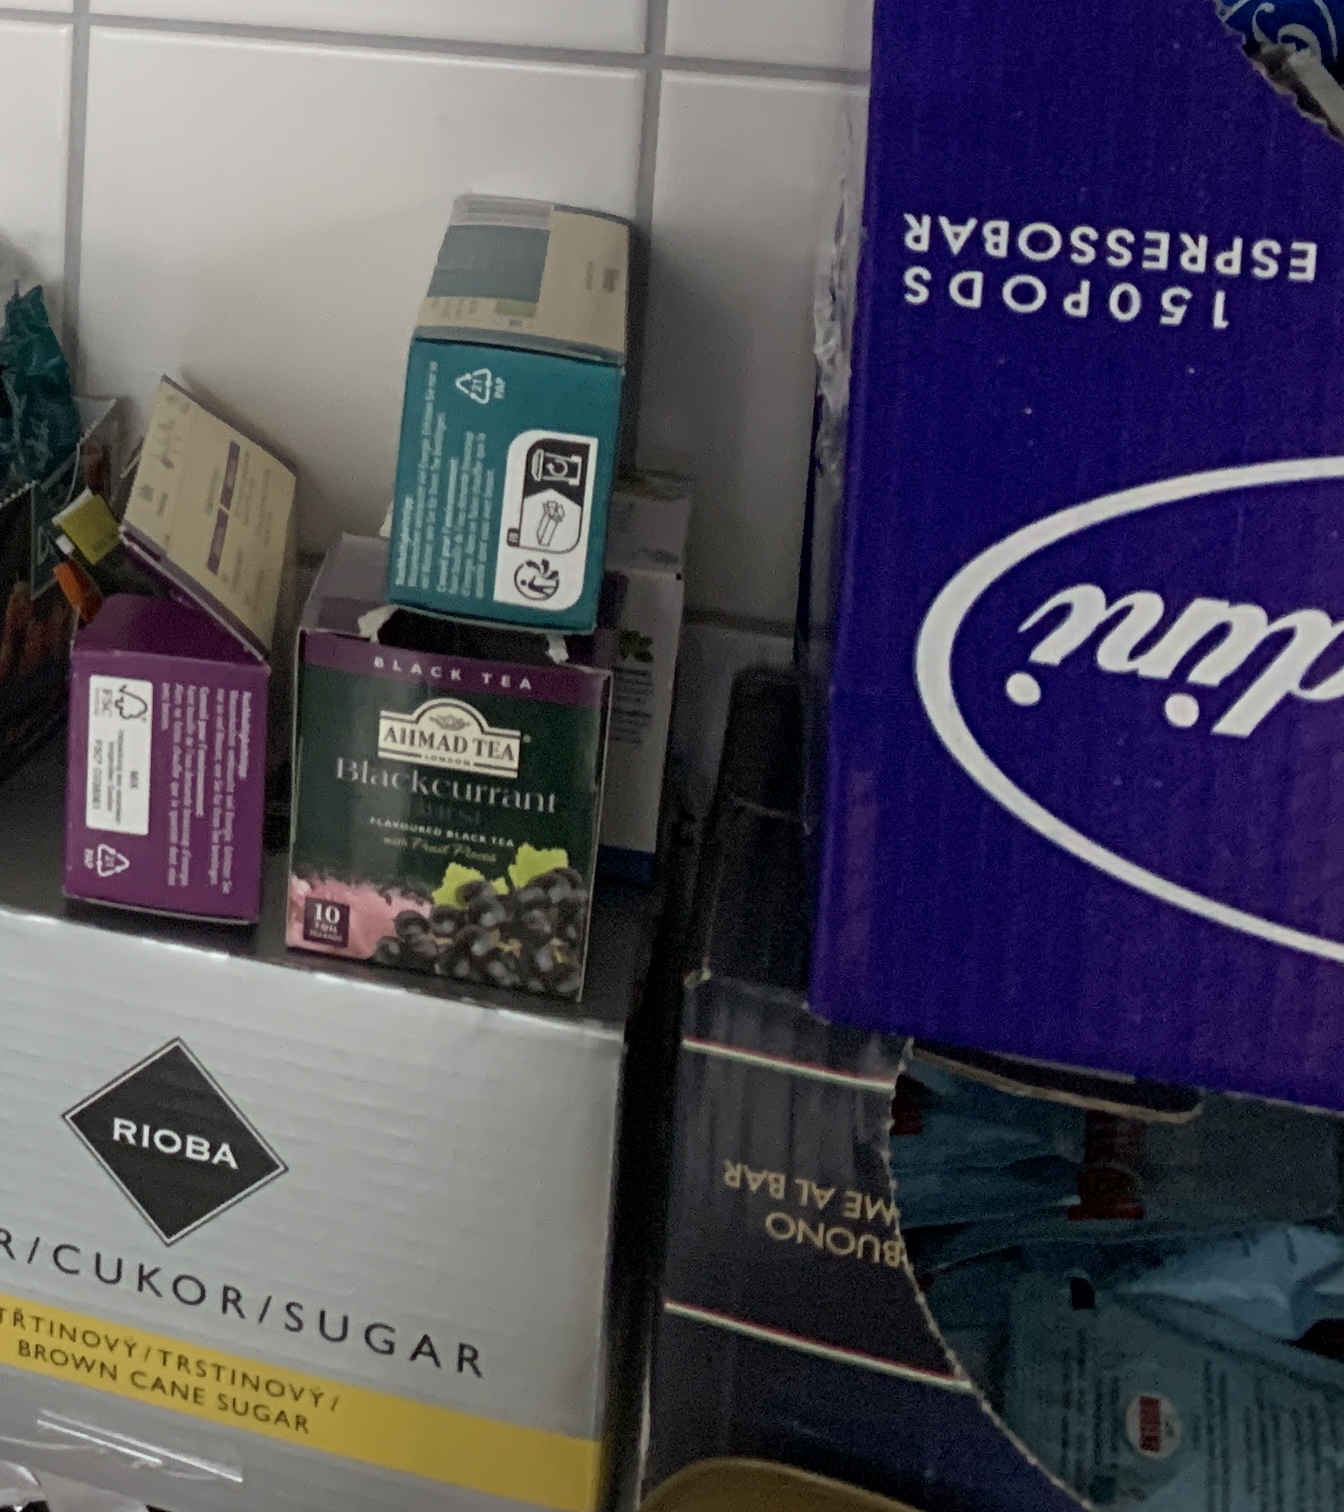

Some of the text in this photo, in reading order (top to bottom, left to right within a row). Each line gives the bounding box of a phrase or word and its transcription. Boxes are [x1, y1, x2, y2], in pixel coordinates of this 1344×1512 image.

[903, 213, 1318, 283] ESPRESSOBAR
[373, 655, 533, 690] BLACK TEA
[383, 725, 515, 762] AHMAD TEA
[423, 753, 472, 767] LONDON
[335, 755, 558, 815] Blackcurrant
[369, 816, 515, 848] FLAVOURED BLACK TEA
[314, 903, 341, 924] 10
[110, 1117, 239, 1171] RIOBA
[721, 1158, 787, 1201] BAR
[793, 1177, 837, 1211] AL
[764, 1210, 909, 1271] BUONO
[17, 1339, 310, 1435] BROWN CANE SUGAR
